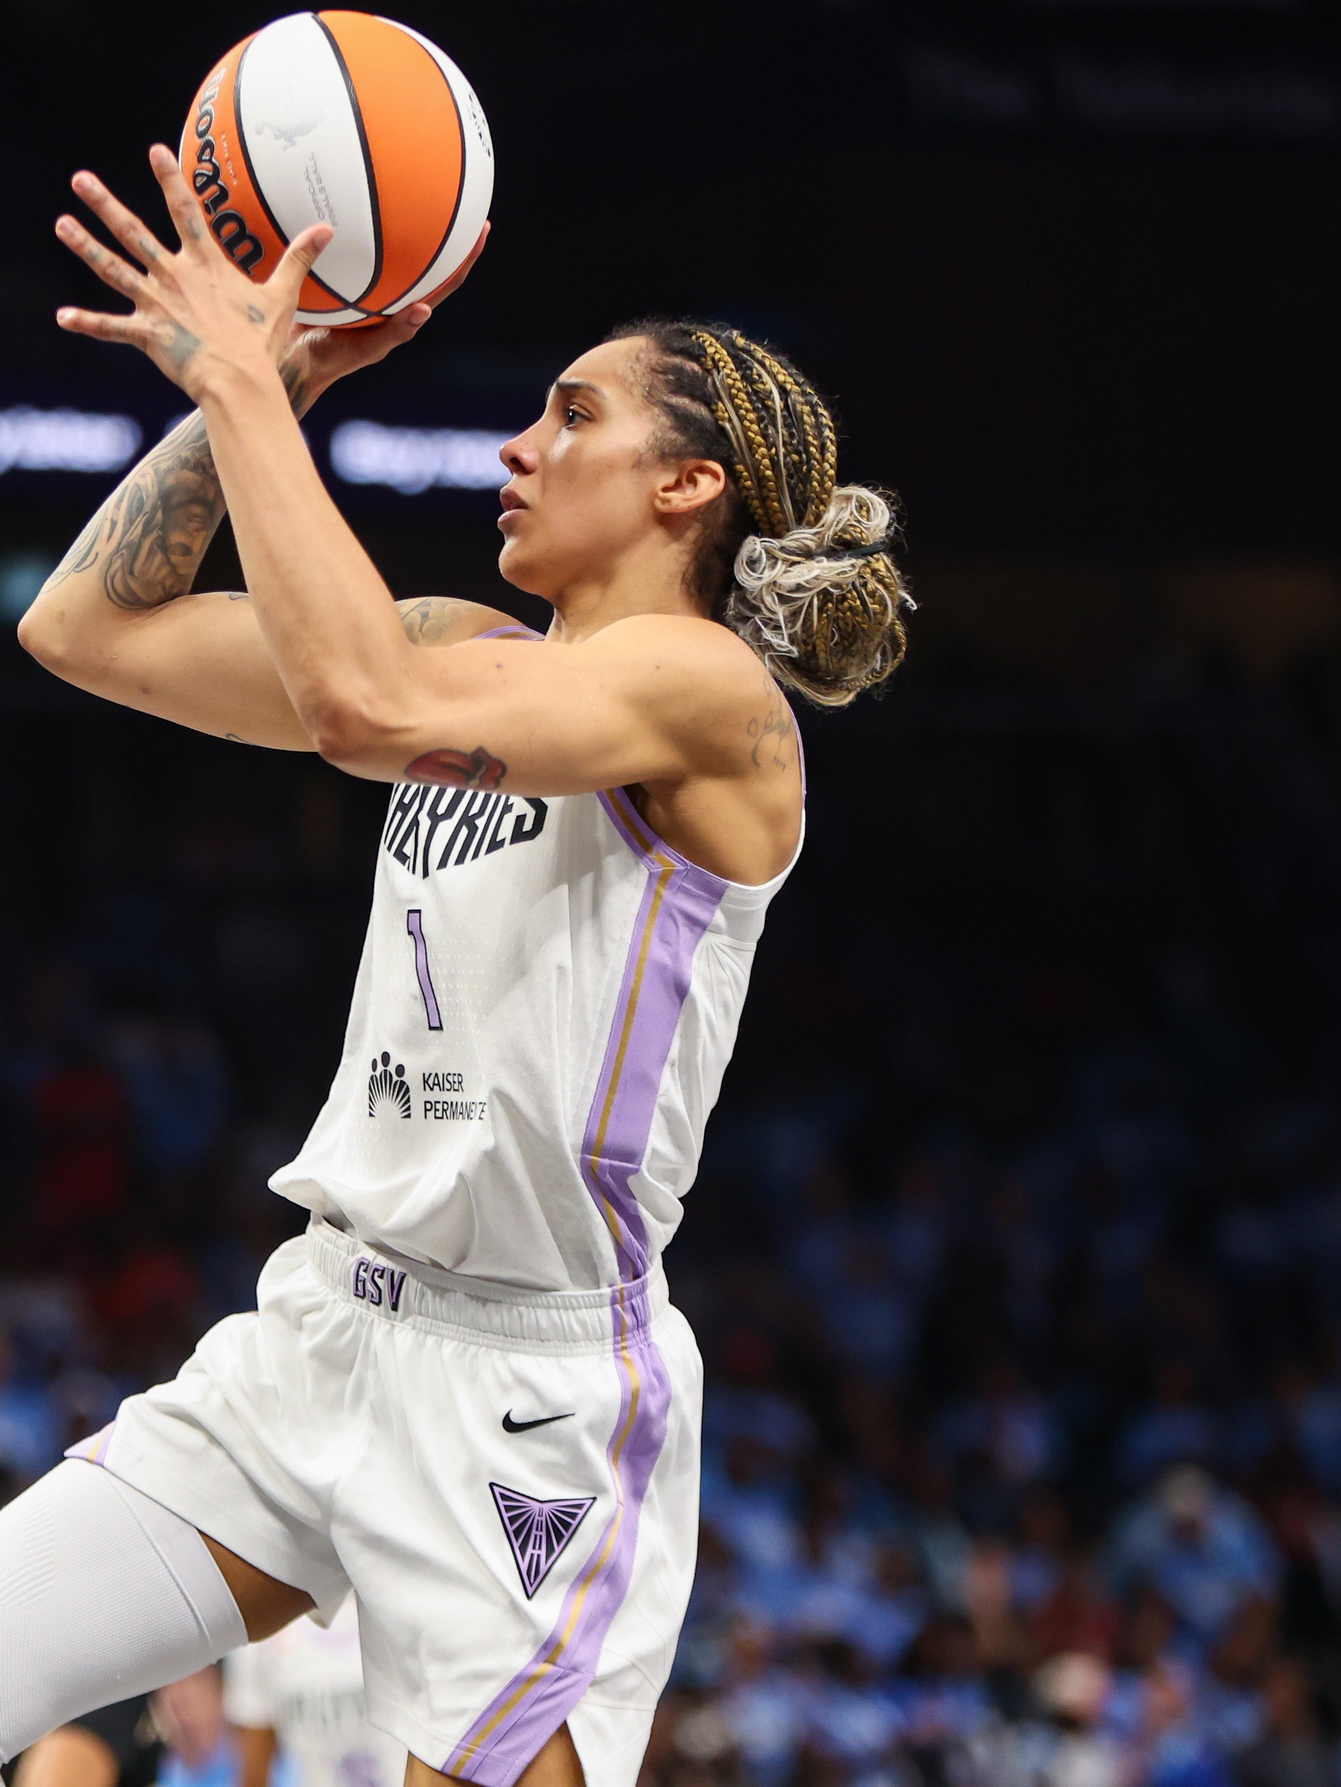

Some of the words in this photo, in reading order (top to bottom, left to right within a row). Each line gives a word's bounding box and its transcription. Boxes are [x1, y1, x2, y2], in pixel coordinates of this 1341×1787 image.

[193, 67, 264, 276] Wilson
[406, 908, 445, 1032] 1
[422, 1072, 464, 1092] KAISER
[352, 1255, 407, 1312] GSV
